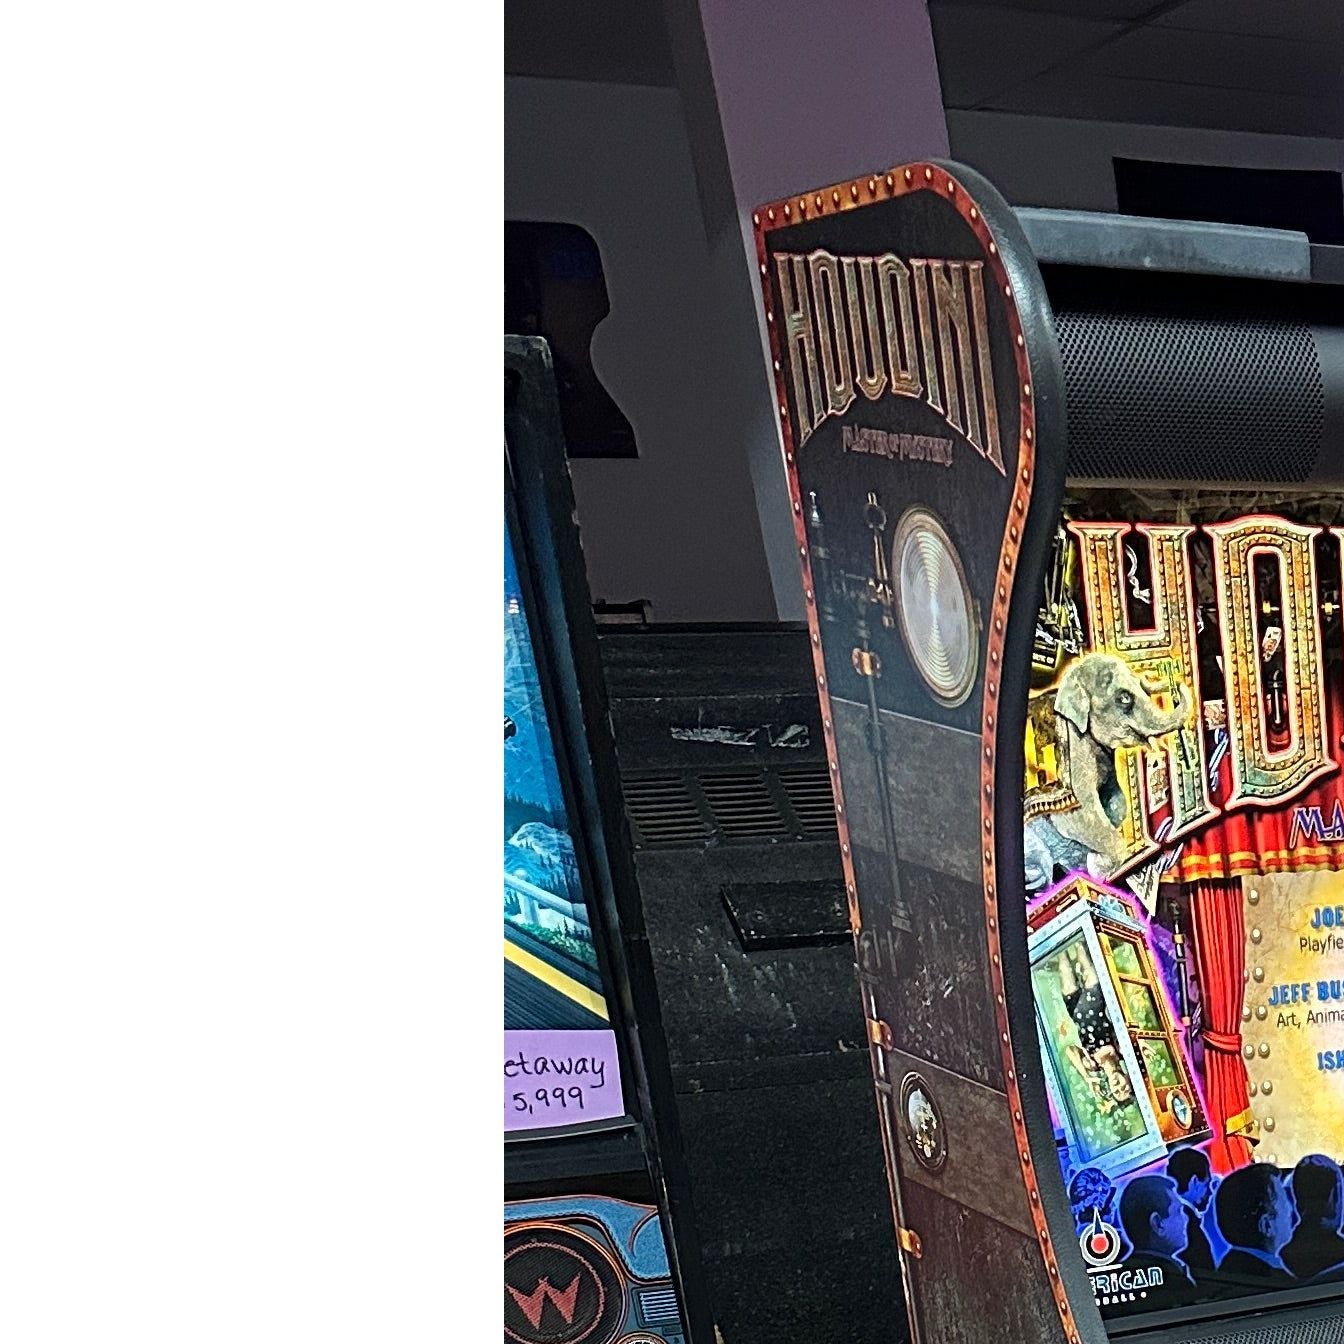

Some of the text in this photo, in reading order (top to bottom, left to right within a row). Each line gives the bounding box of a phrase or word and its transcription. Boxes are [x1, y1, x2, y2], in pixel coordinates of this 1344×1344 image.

[773, 249, 1007, 478] HOUDINI
[1310, 904, 1344, 929] JOE
[1268, 983, 1311, 1007] JEFF
[1277, 1011, 1302, 1029] Art,
